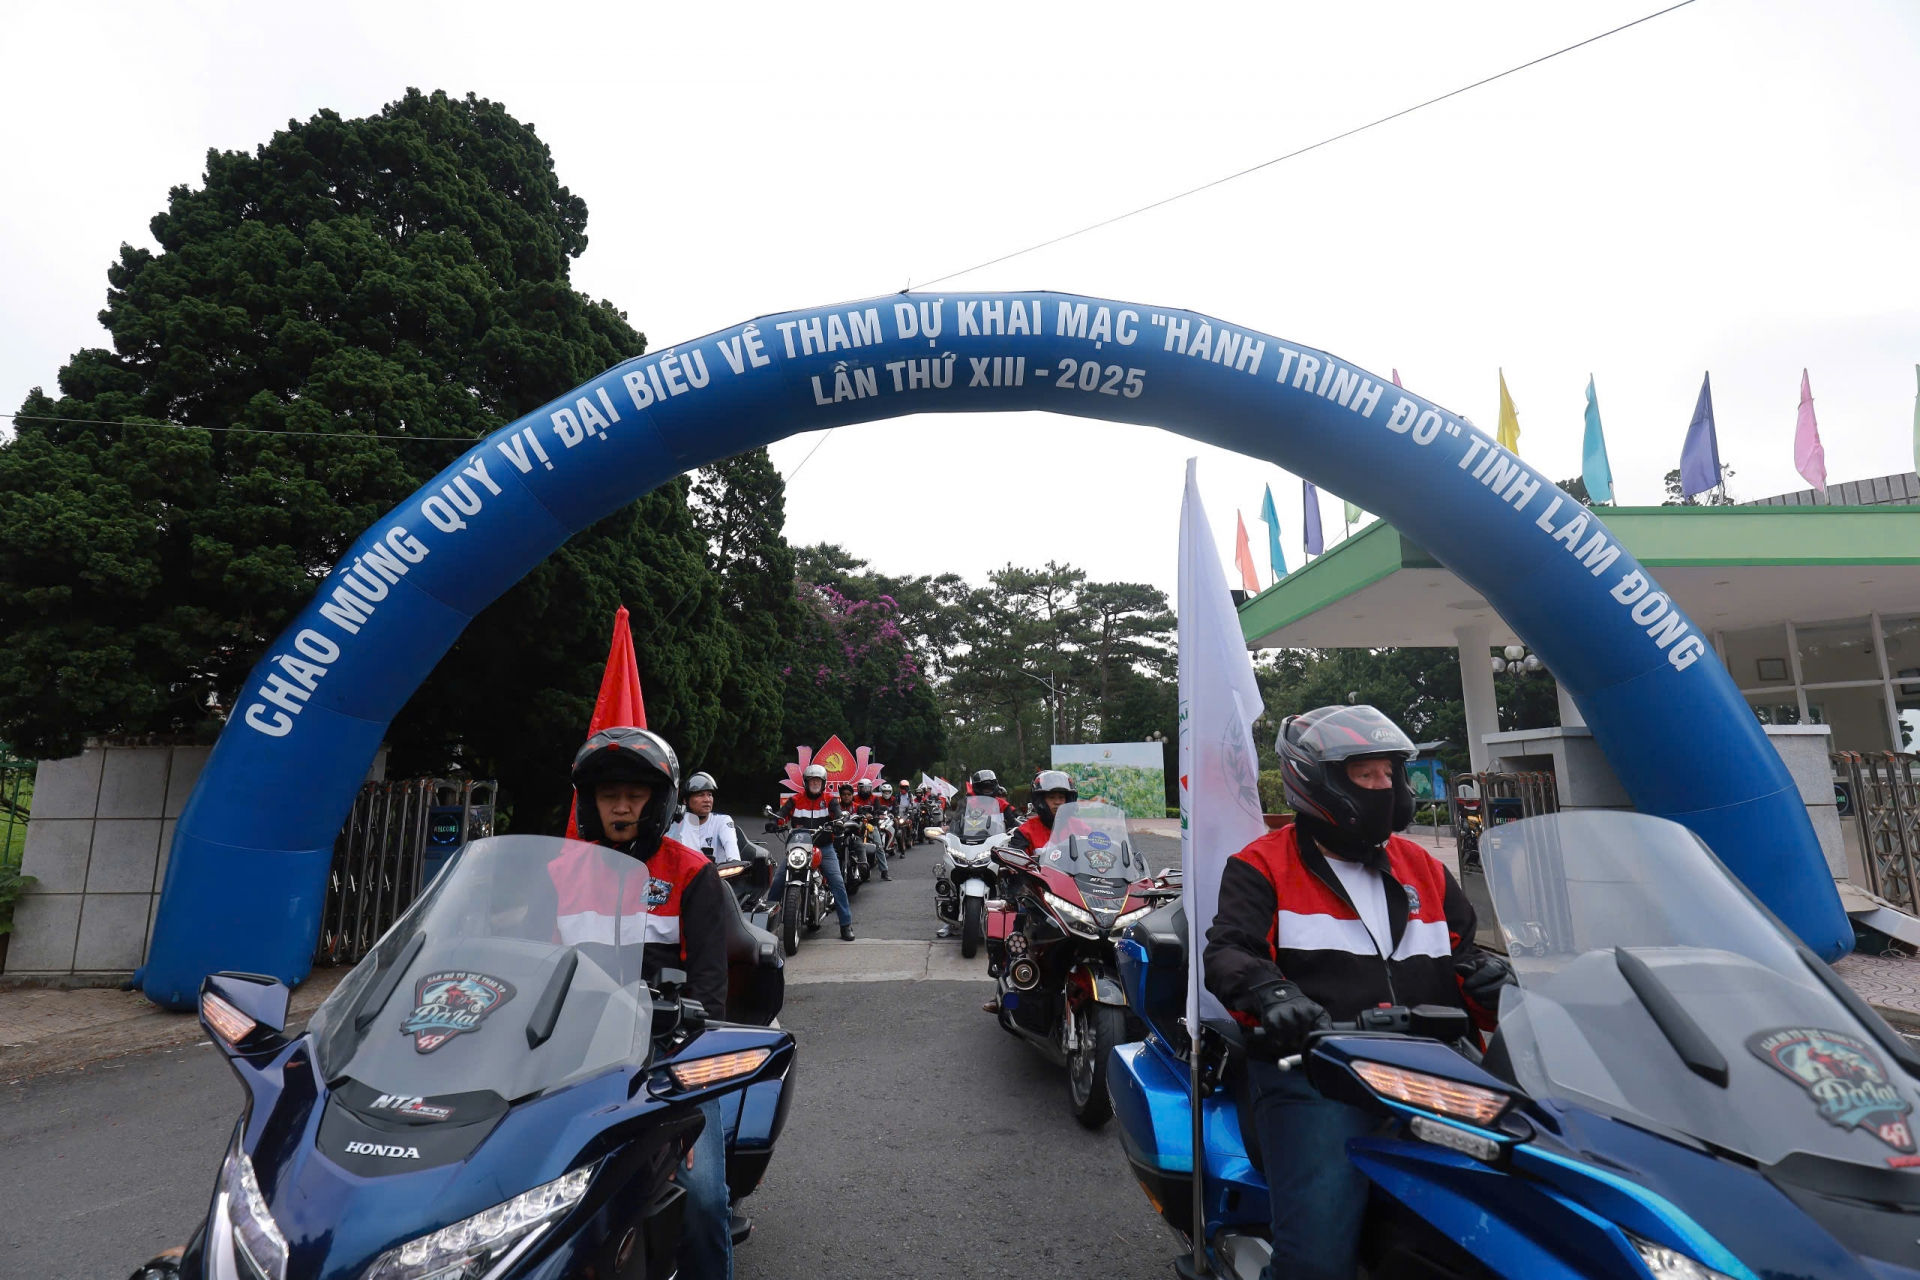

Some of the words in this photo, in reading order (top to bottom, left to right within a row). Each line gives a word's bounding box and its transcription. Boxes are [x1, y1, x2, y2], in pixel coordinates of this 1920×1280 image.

[812, 360, 879, 406] LẦN
[885, 352, 957, 392] THỨ
[968, 356, 1026, 387] XIII
[1034, 368, 1049, 377] -
[1055, 357, 1147, 399] 2025
[244, 627, 341, 738] CHÀO
[318, 525, 430, 636] MỪNG
[420, 454, 503, 533] QUÝ
[496, 426, 554, 474] VỊ
[550, 386, 621, 449] ĐẠI
[622, 347, 711, 411] BIỂU
[716, 323, 771, 375] VỀ
[776, 307, 885, 359] THAM
[898, 298, 945, 348] DỰ
[957, 300, 1043, 337] KHAI
[1056, 302, 1139, 350] MẠC
[1151, 311, 1267, 376] "HÀNH
[1275, 345, 1385, 419] TRÌNH
[1385, 396, 1462, 446] ĐỎ"
[1458, 433, 1542, 512] TỈNH
[1535, 496, 1622, 578] LÂM
[1608, 568, 1706, 673] ĐỒNG
[345, 1141, 420, 1158] HONDA
